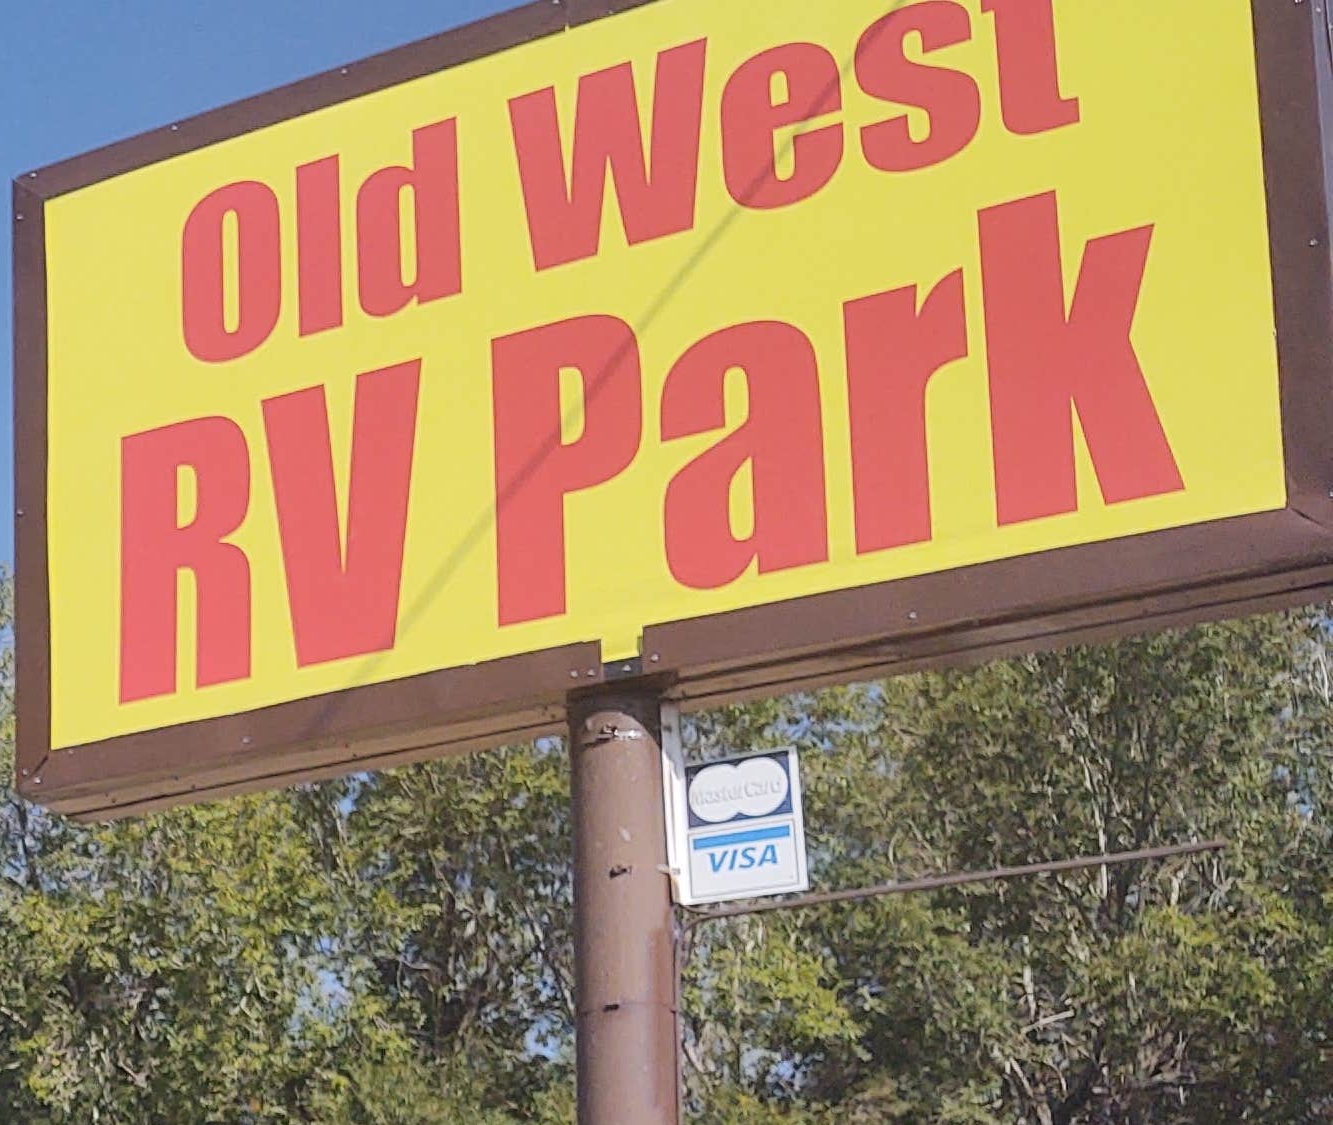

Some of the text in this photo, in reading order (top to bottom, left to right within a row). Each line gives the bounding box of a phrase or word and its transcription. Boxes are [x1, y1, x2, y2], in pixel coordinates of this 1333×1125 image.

[183, 0, 1080, 361] Old West
[119, 190, 1185, 704] RV Park
[708, 843, 778, 873] VISA
